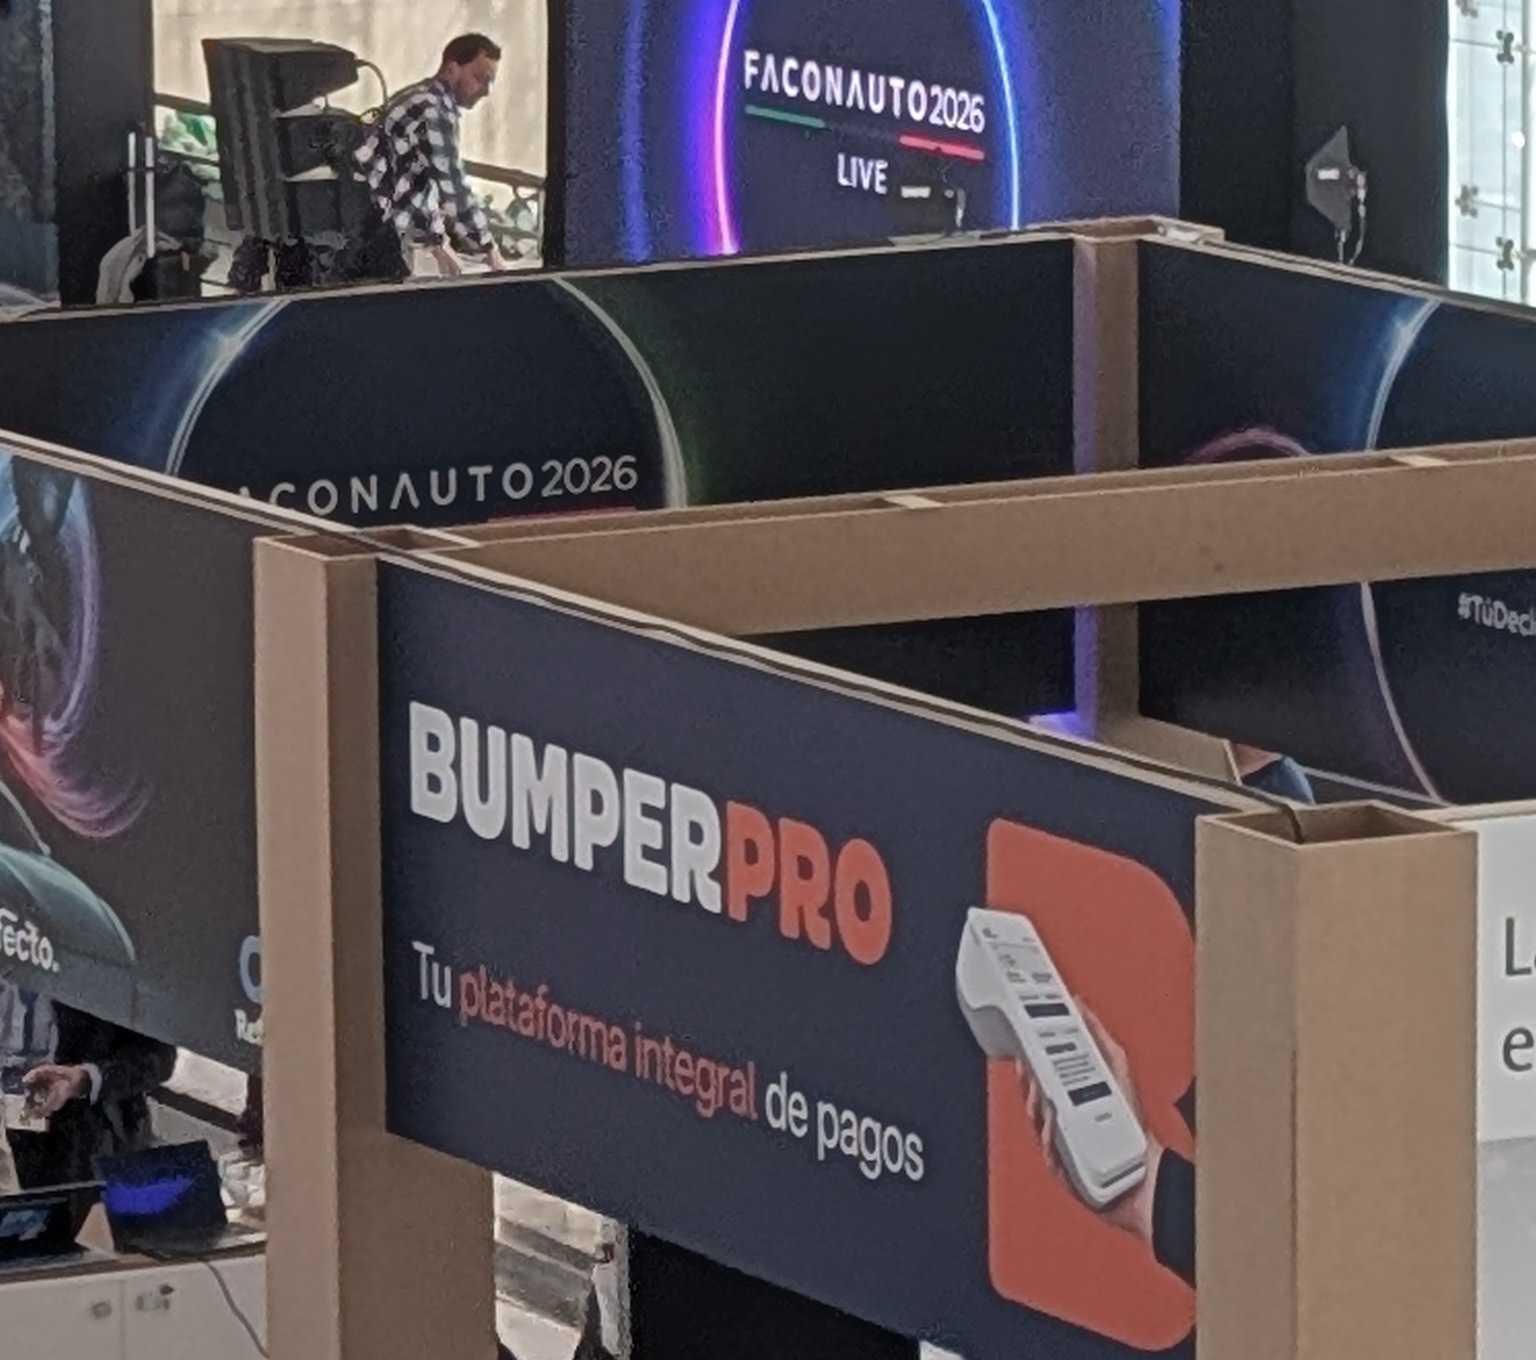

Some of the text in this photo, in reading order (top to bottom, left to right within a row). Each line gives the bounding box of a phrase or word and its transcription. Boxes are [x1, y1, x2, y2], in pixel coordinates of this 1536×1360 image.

[836, 152, 889, 195] LIVE
[1505, 917, 1536, 977] L
[411, 940, 925, 1181] Tu plataforma integral de pagos
